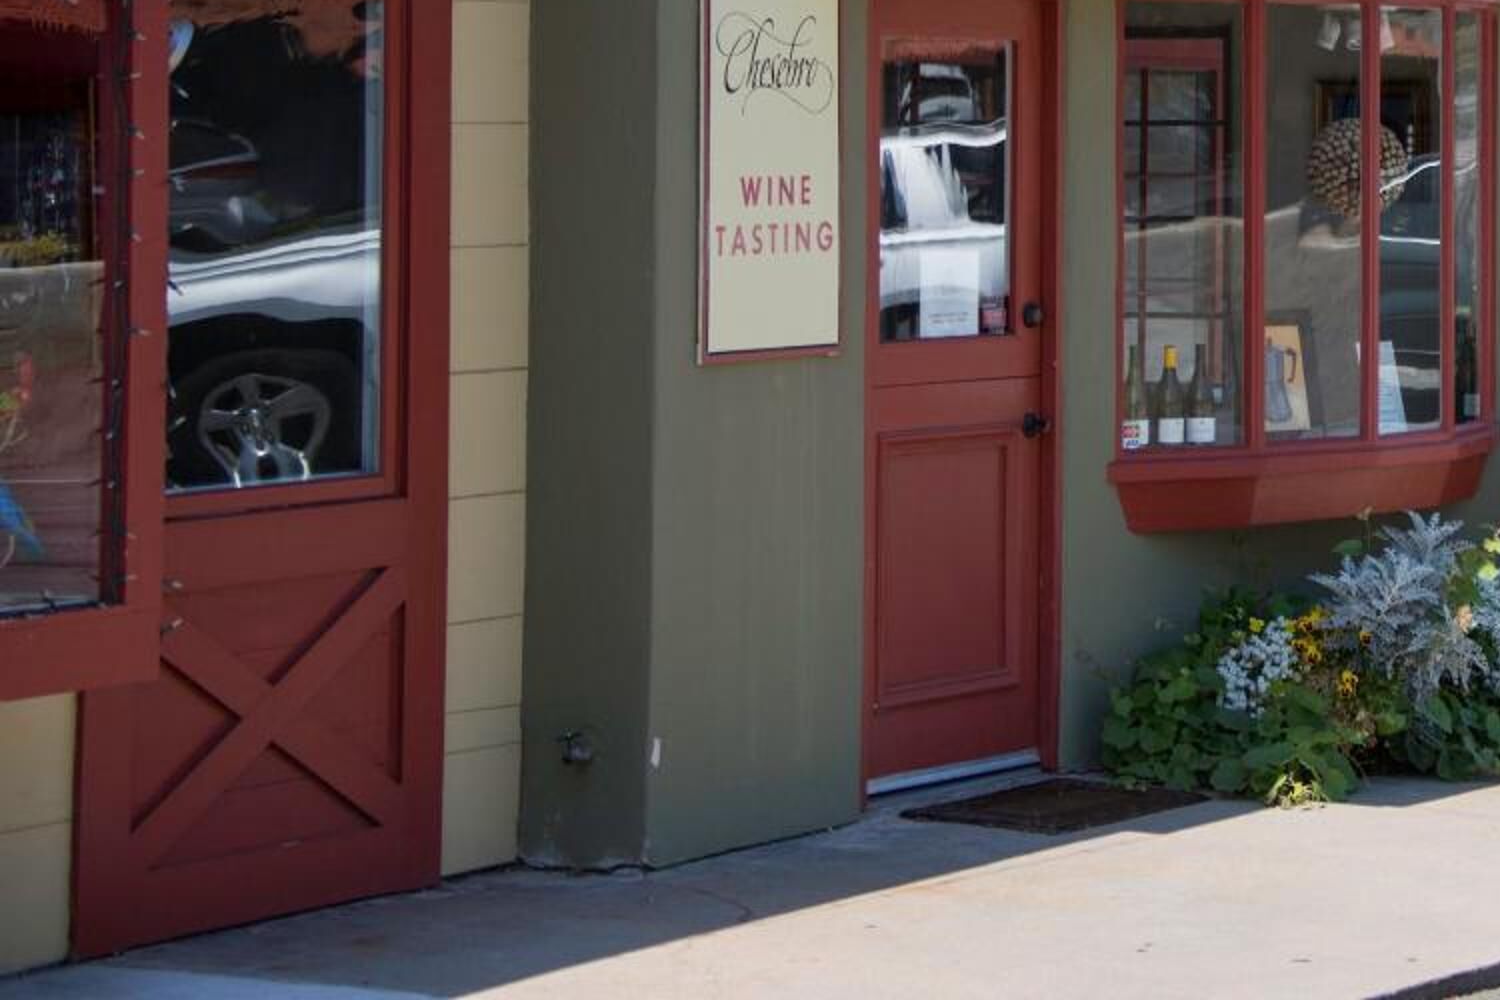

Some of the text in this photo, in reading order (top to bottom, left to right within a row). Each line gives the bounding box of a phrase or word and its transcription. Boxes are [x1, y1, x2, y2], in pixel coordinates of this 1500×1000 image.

[716, 10, 834, 119] Chesebro
[739, 175, 812, 208] WINE
[715, 221, 834, 257] TASTING
